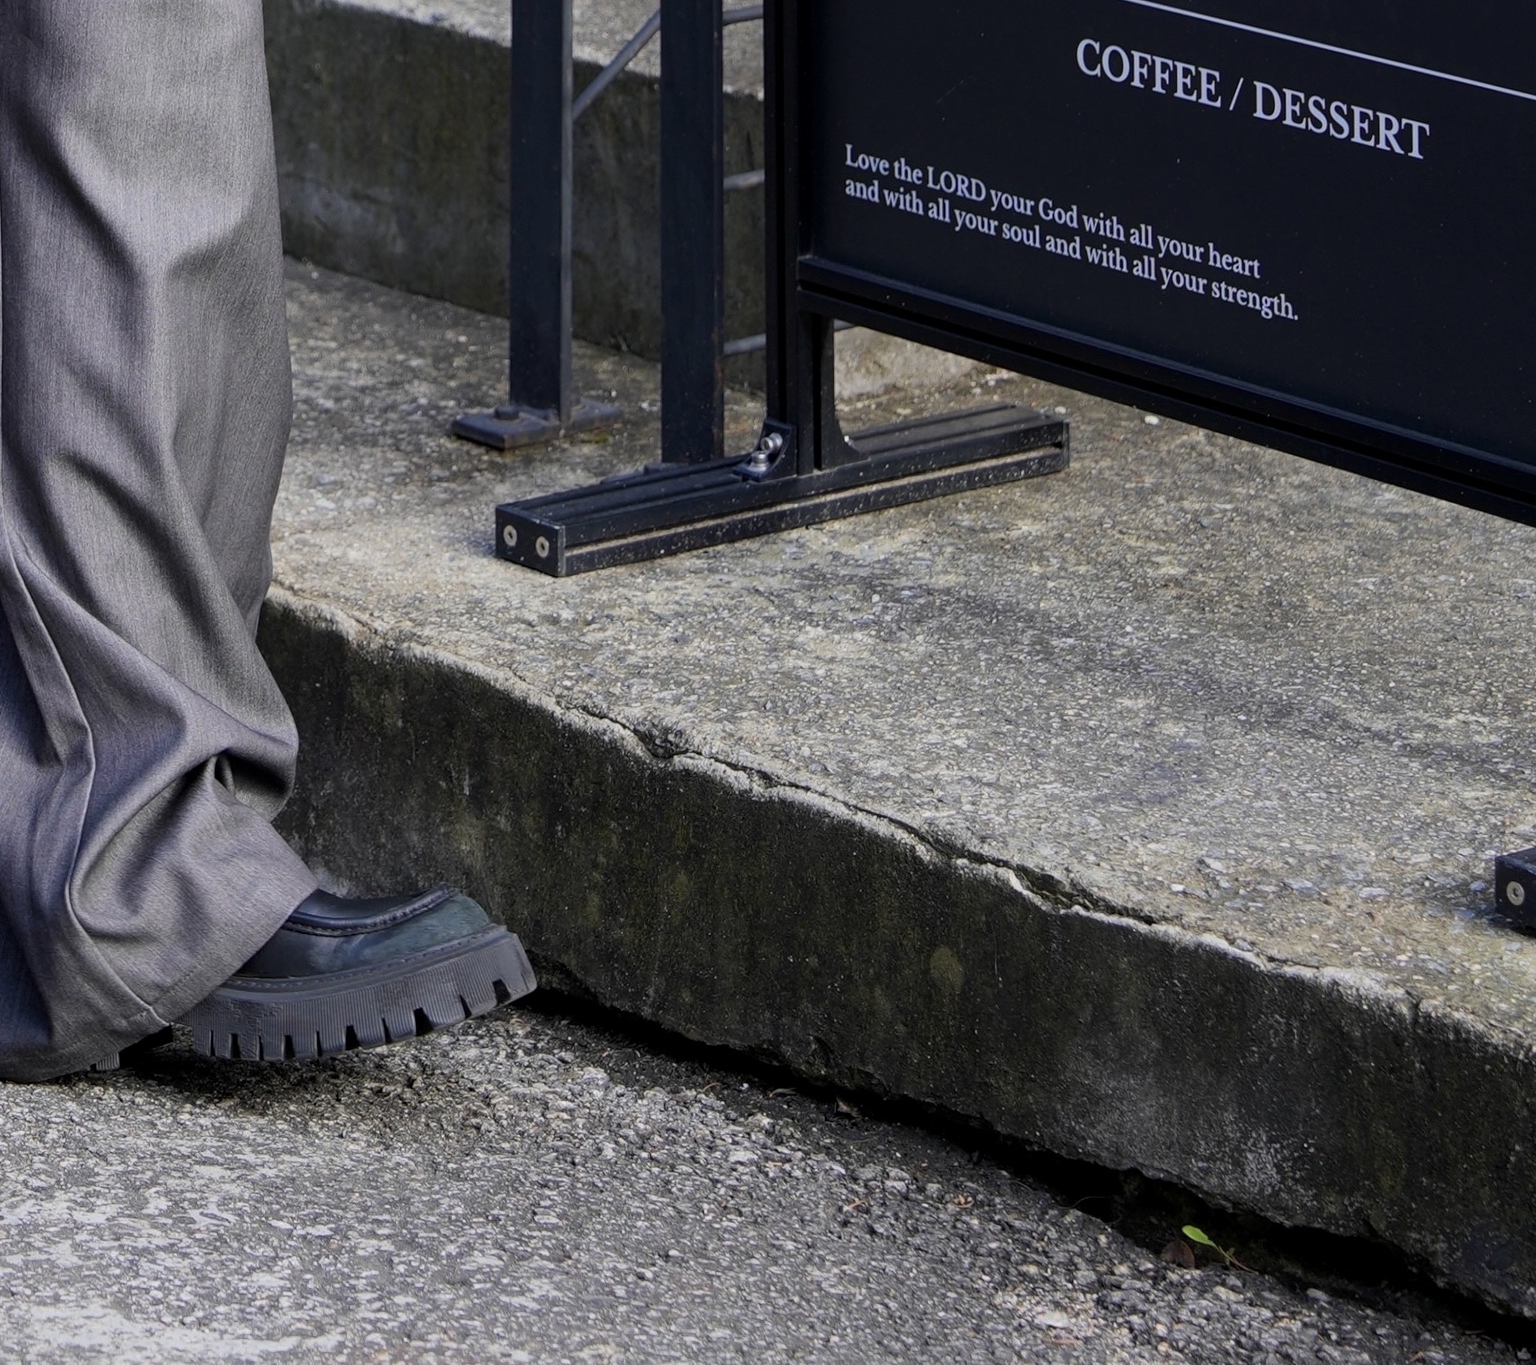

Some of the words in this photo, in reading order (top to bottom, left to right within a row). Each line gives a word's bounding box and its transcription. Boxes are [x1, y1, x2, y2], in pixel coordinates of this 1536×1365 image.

[1076, 38, 1222, 108] COFFEE
[1228, 75, 1244, 112] /
[1252, 80, 1430, 160] DESSERT
[845, 143, 890, 176] Love
[893, 157, 923, 185] the
[926, 165, 987, 202] LORD
[989, 189, 1035, 216] your
[1038, 197, 1079, 229] God
[1081, 212, 1126, 242] with
[1129, 223, 1154, 250] all
[1156, 235, 1205, 263] your
[1207, 242, 1261, 279] heart
[845, 177, 881, 203] and
[882, 186, 924, 216] with
[927, 197, 951, 223] all
[953, 208, 999, 236] your
[1001, 222, 1042, 249] soul
[1045, 235, 1082, 260] and
[1084, 243, 1129, 273] with
[1132, 254, 1157, 281] all
[1159, 266, 1208, 295] your
[1211, 281, 1299, 321] strength.
